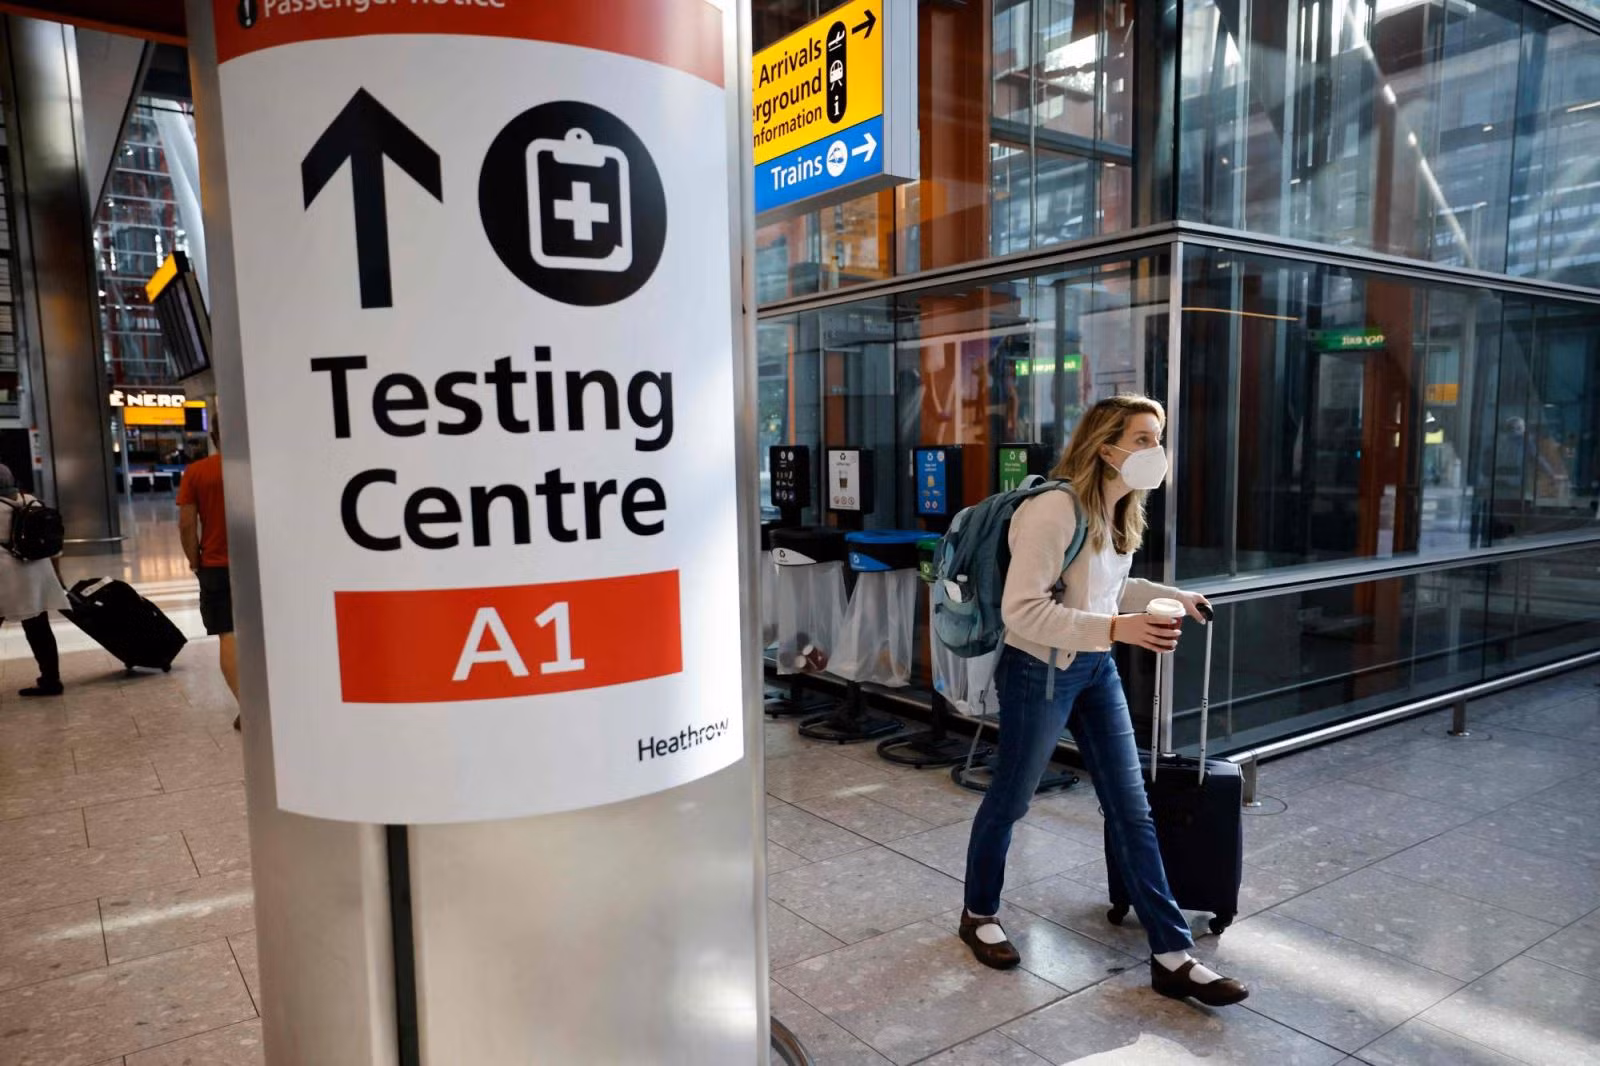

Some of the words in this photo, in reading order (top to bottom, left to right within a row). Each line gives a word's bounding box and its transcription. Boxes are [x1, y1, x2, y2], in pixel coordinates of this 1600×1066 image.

[758, 38, 822, 88] Arrivals
[753, 67, 822, 124] rground
[771, 155, 823, 191] Trains
[310, 345, 675, 452] Testing
[340, 467, 667, 551] Centre
[451, 600, 586, 682] A1
[638, 717, 729, 762] Heathrow
